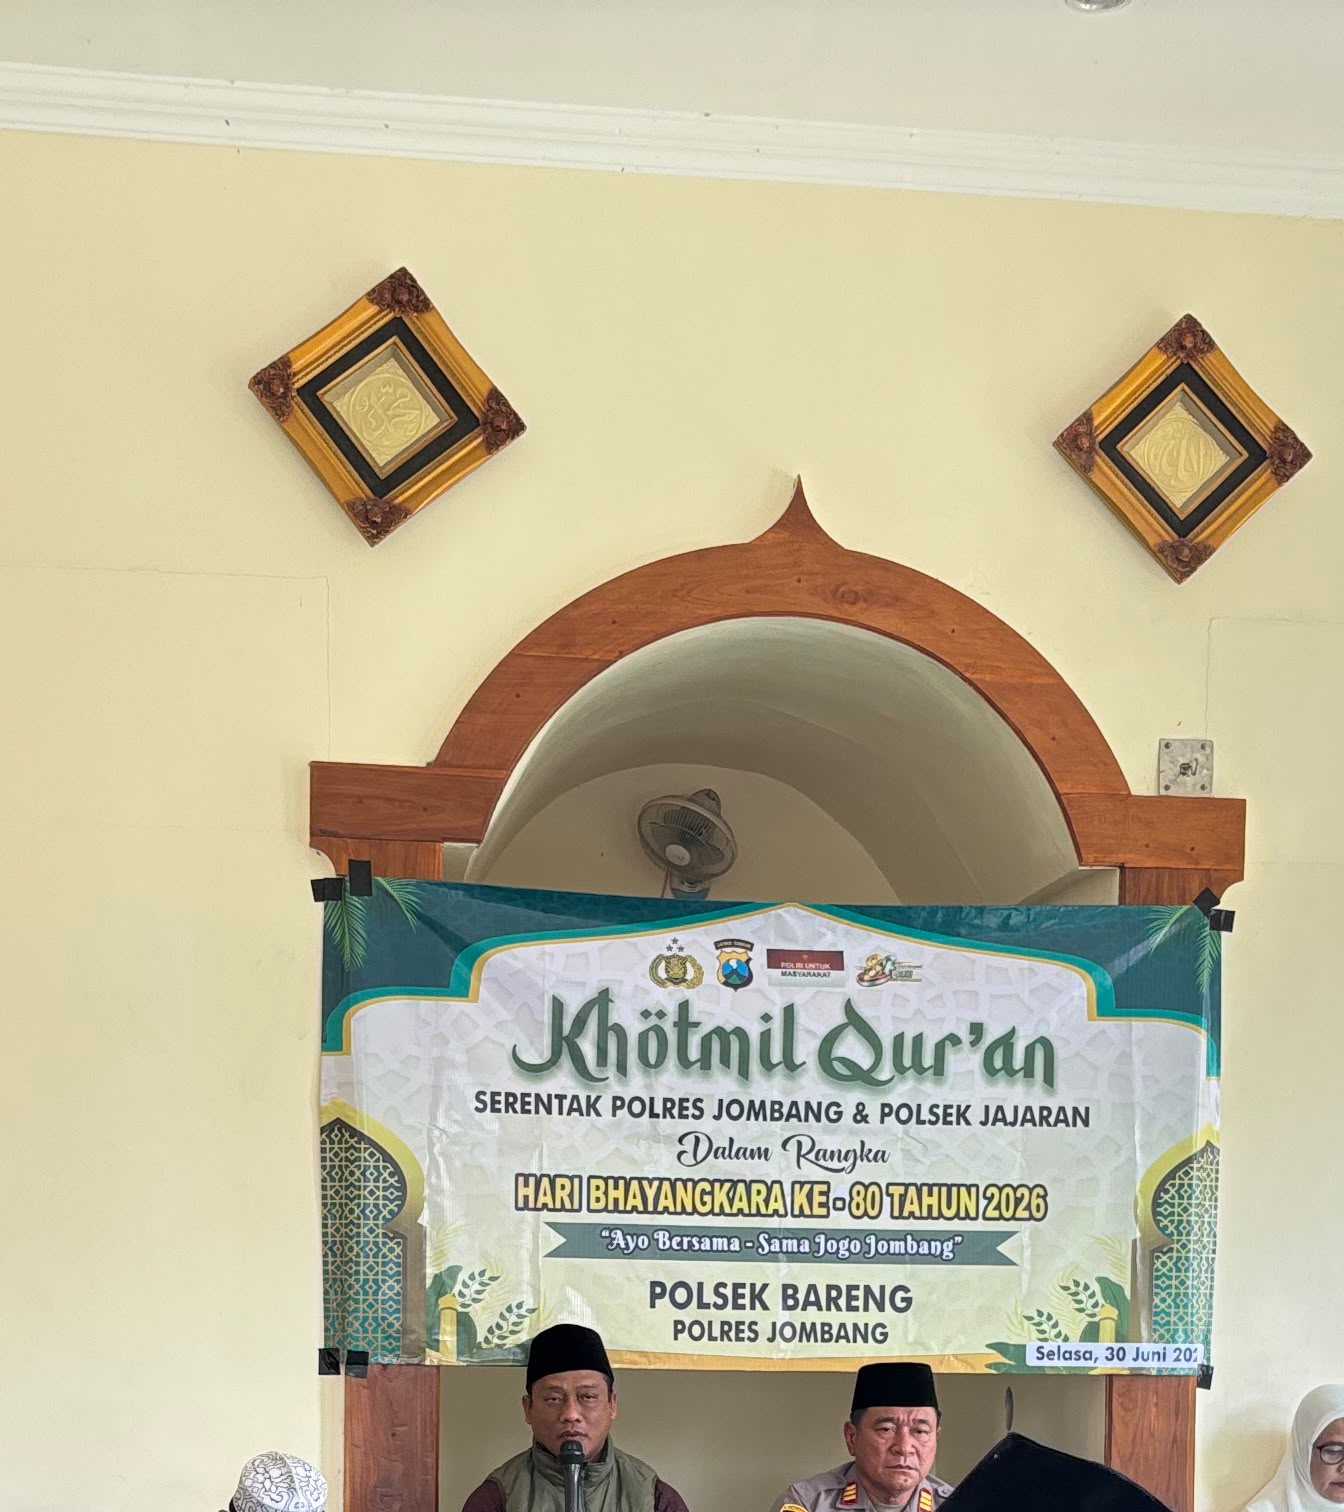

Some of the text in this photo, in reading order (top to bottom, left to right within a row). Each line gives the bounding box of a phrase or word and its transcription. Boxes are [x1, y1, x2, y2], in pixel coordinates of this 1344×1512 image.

[817, 997, 1055, 1089] Qur'an
[474, 1091, 1090, 1128] SERENTAK POLRES JOMBANG & POLSEK JAJARAN
[677, 1131, 891, 1175] Dalam Rangka
[515, 1173, 582, 1212] HARI
[587, 1175, 786, 1217] BHAYANGKARA
[849, 1181, 883, 1220] 80
[886, 1182, 980, 1221] TAHUN
[982, 1184, 1047, 1222] 2026
[653, 1231, 741, 1252] Bersama
[757, 1232, 811, 1254] Sama
[814, 1234, 861, 1259] Jogo
[649, 1280, 913, 1313] POLSEK BARENG
[673, 1320, 889, 1344] POLRES JOMBANG
[1036, 1346, 1099, 1364] Selasa,
[1105, 1347, 1126, 1362] 30
[1132, 1347, 1167, 1362] Juni
